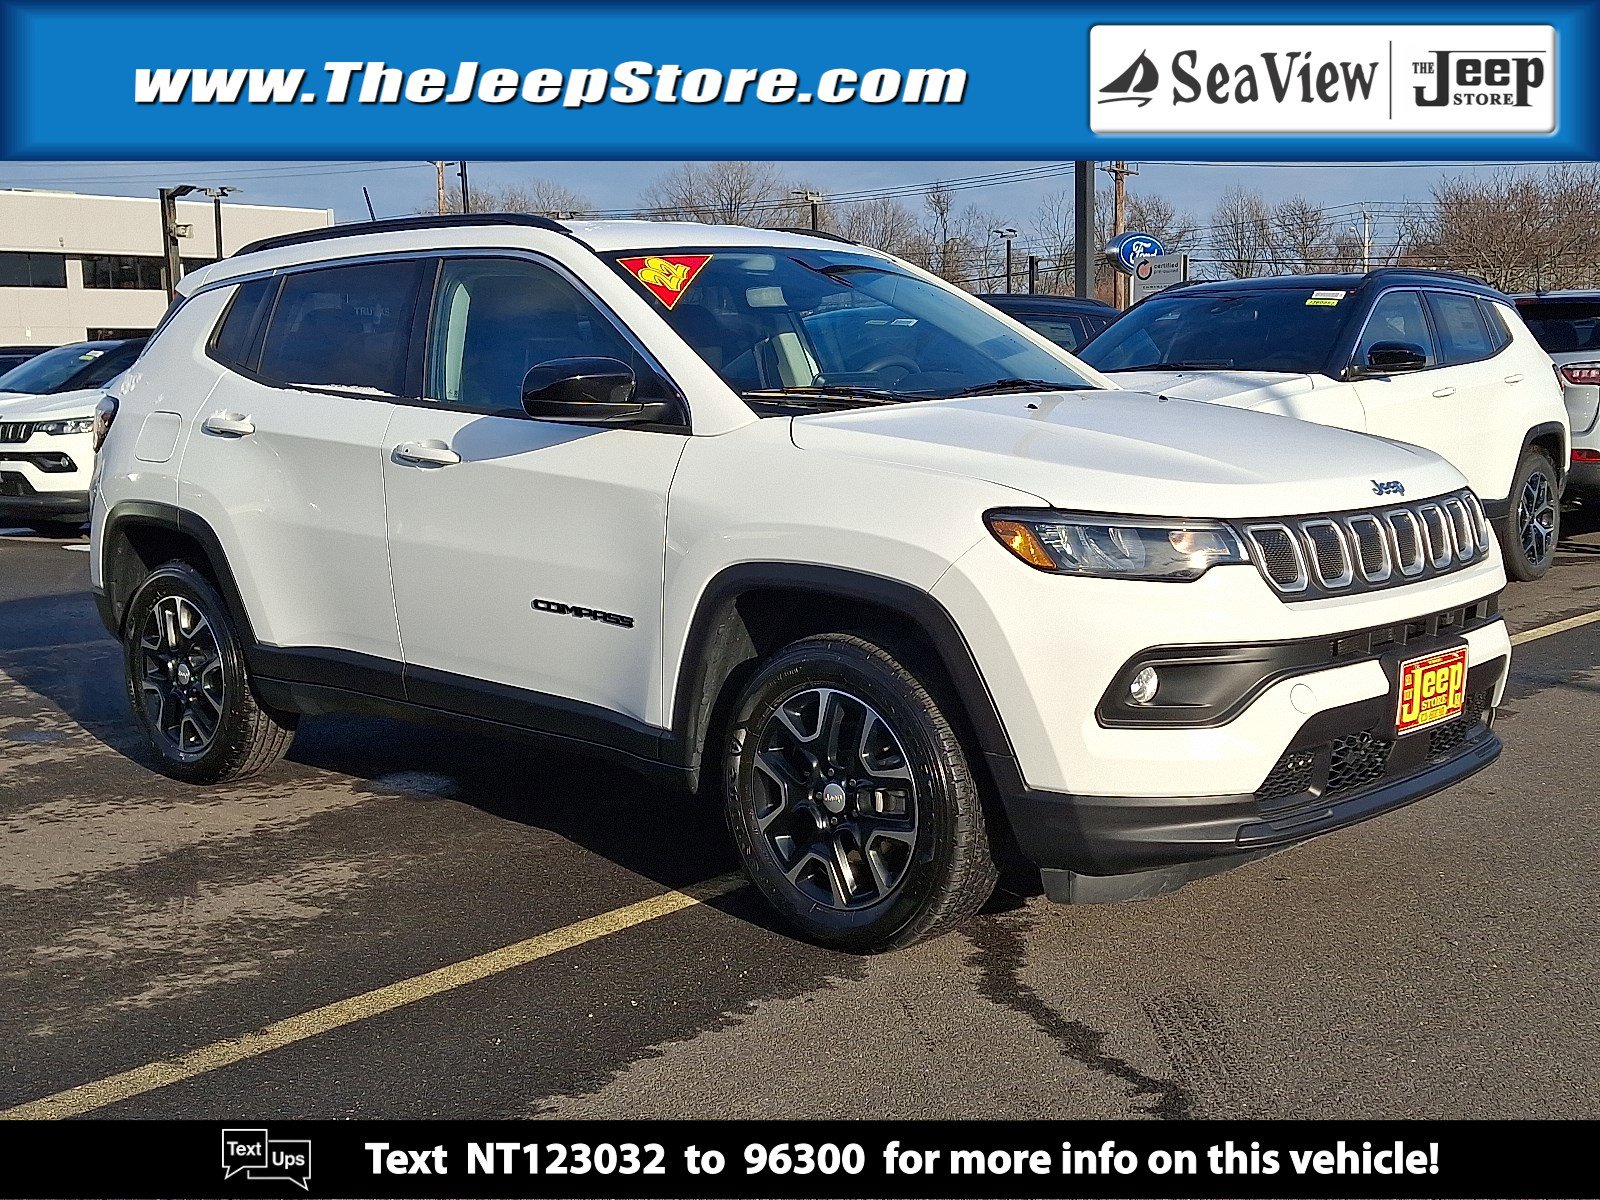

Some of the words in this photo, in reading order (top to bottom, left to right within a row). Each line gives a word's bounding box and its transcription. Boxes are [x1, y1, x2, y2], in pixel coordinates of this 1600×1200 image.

[637, 257, 691, 292] 22
[1370, 479, 1405, 497] Jeep
[530, 598, 635, 630] COMPASS
[1401, 661, 1463, 724] Jeep
